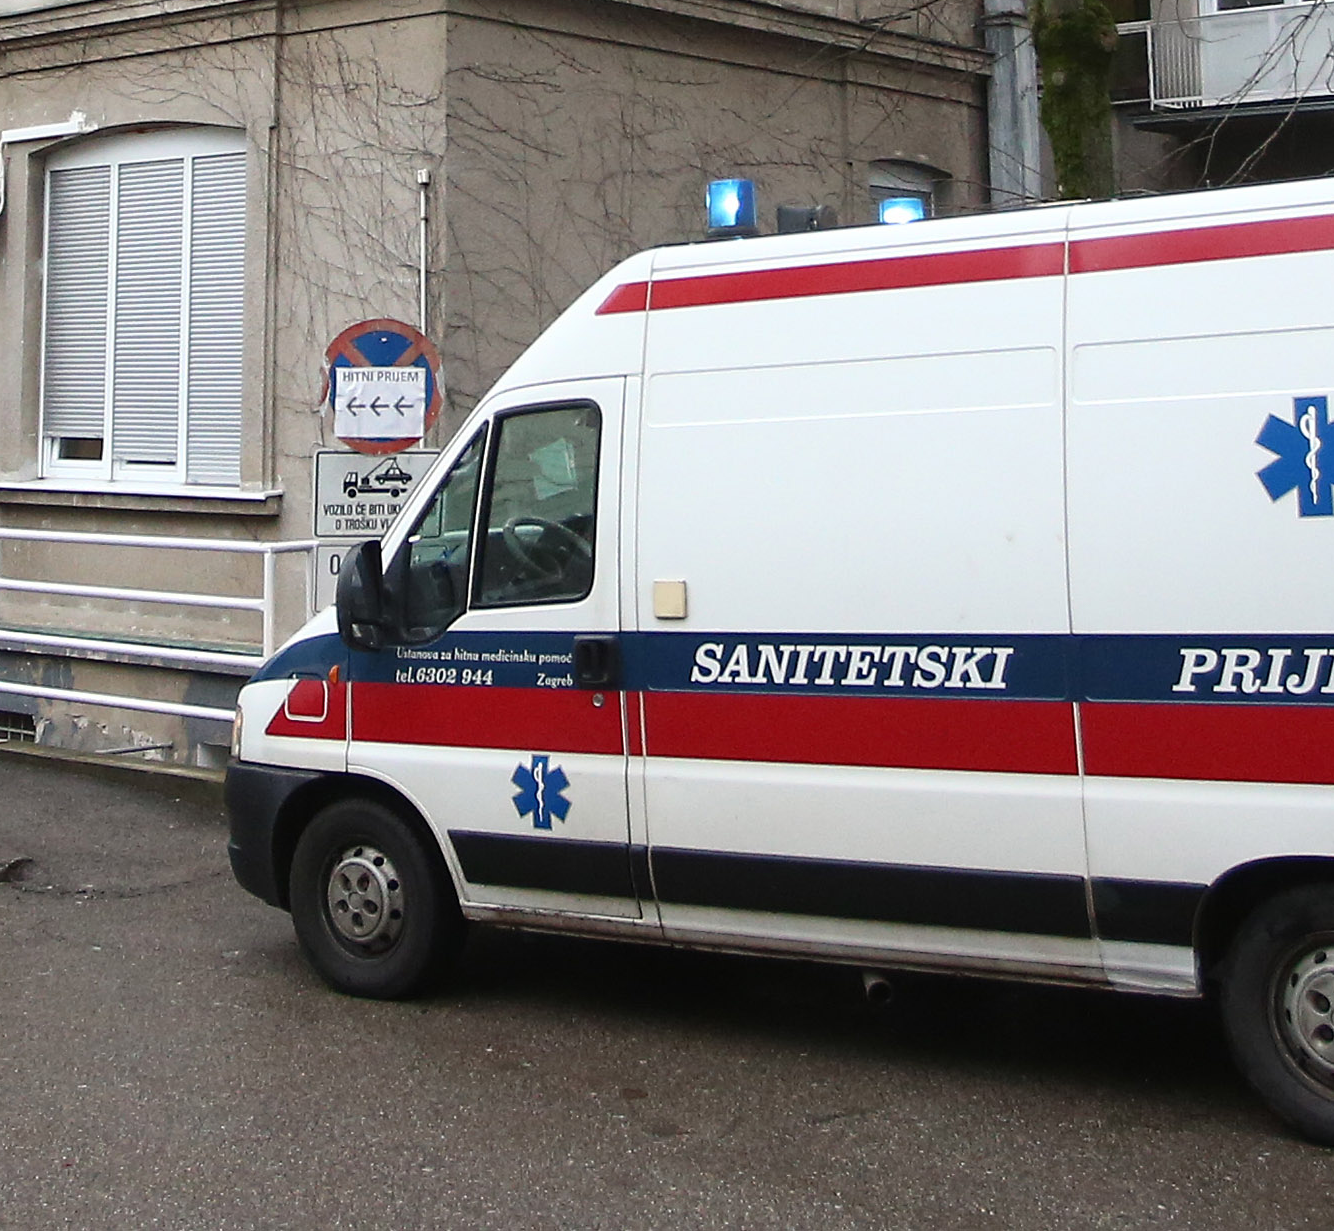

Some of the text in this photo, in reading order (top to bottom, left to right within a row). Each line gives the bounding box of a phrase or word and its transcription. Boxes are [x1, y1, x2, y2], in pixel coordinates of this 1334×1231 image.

[342, 371, 419, 383] HITNI PRIJEM
[323, 504, 353, 516] VOZILO
[355, 502, 367, 516] ĆE
[369, 504, 385, 515] BITI
[345, 516, 377, 531] TROŠKU
[396, 647, 572, 666] Ustanova za hitnu medicinsku pomoć
[690, 642, 1015, 691] SANITETSKI
[461, 670, 493, 686] 944
[536, 672, 574, 689] Zagreb
